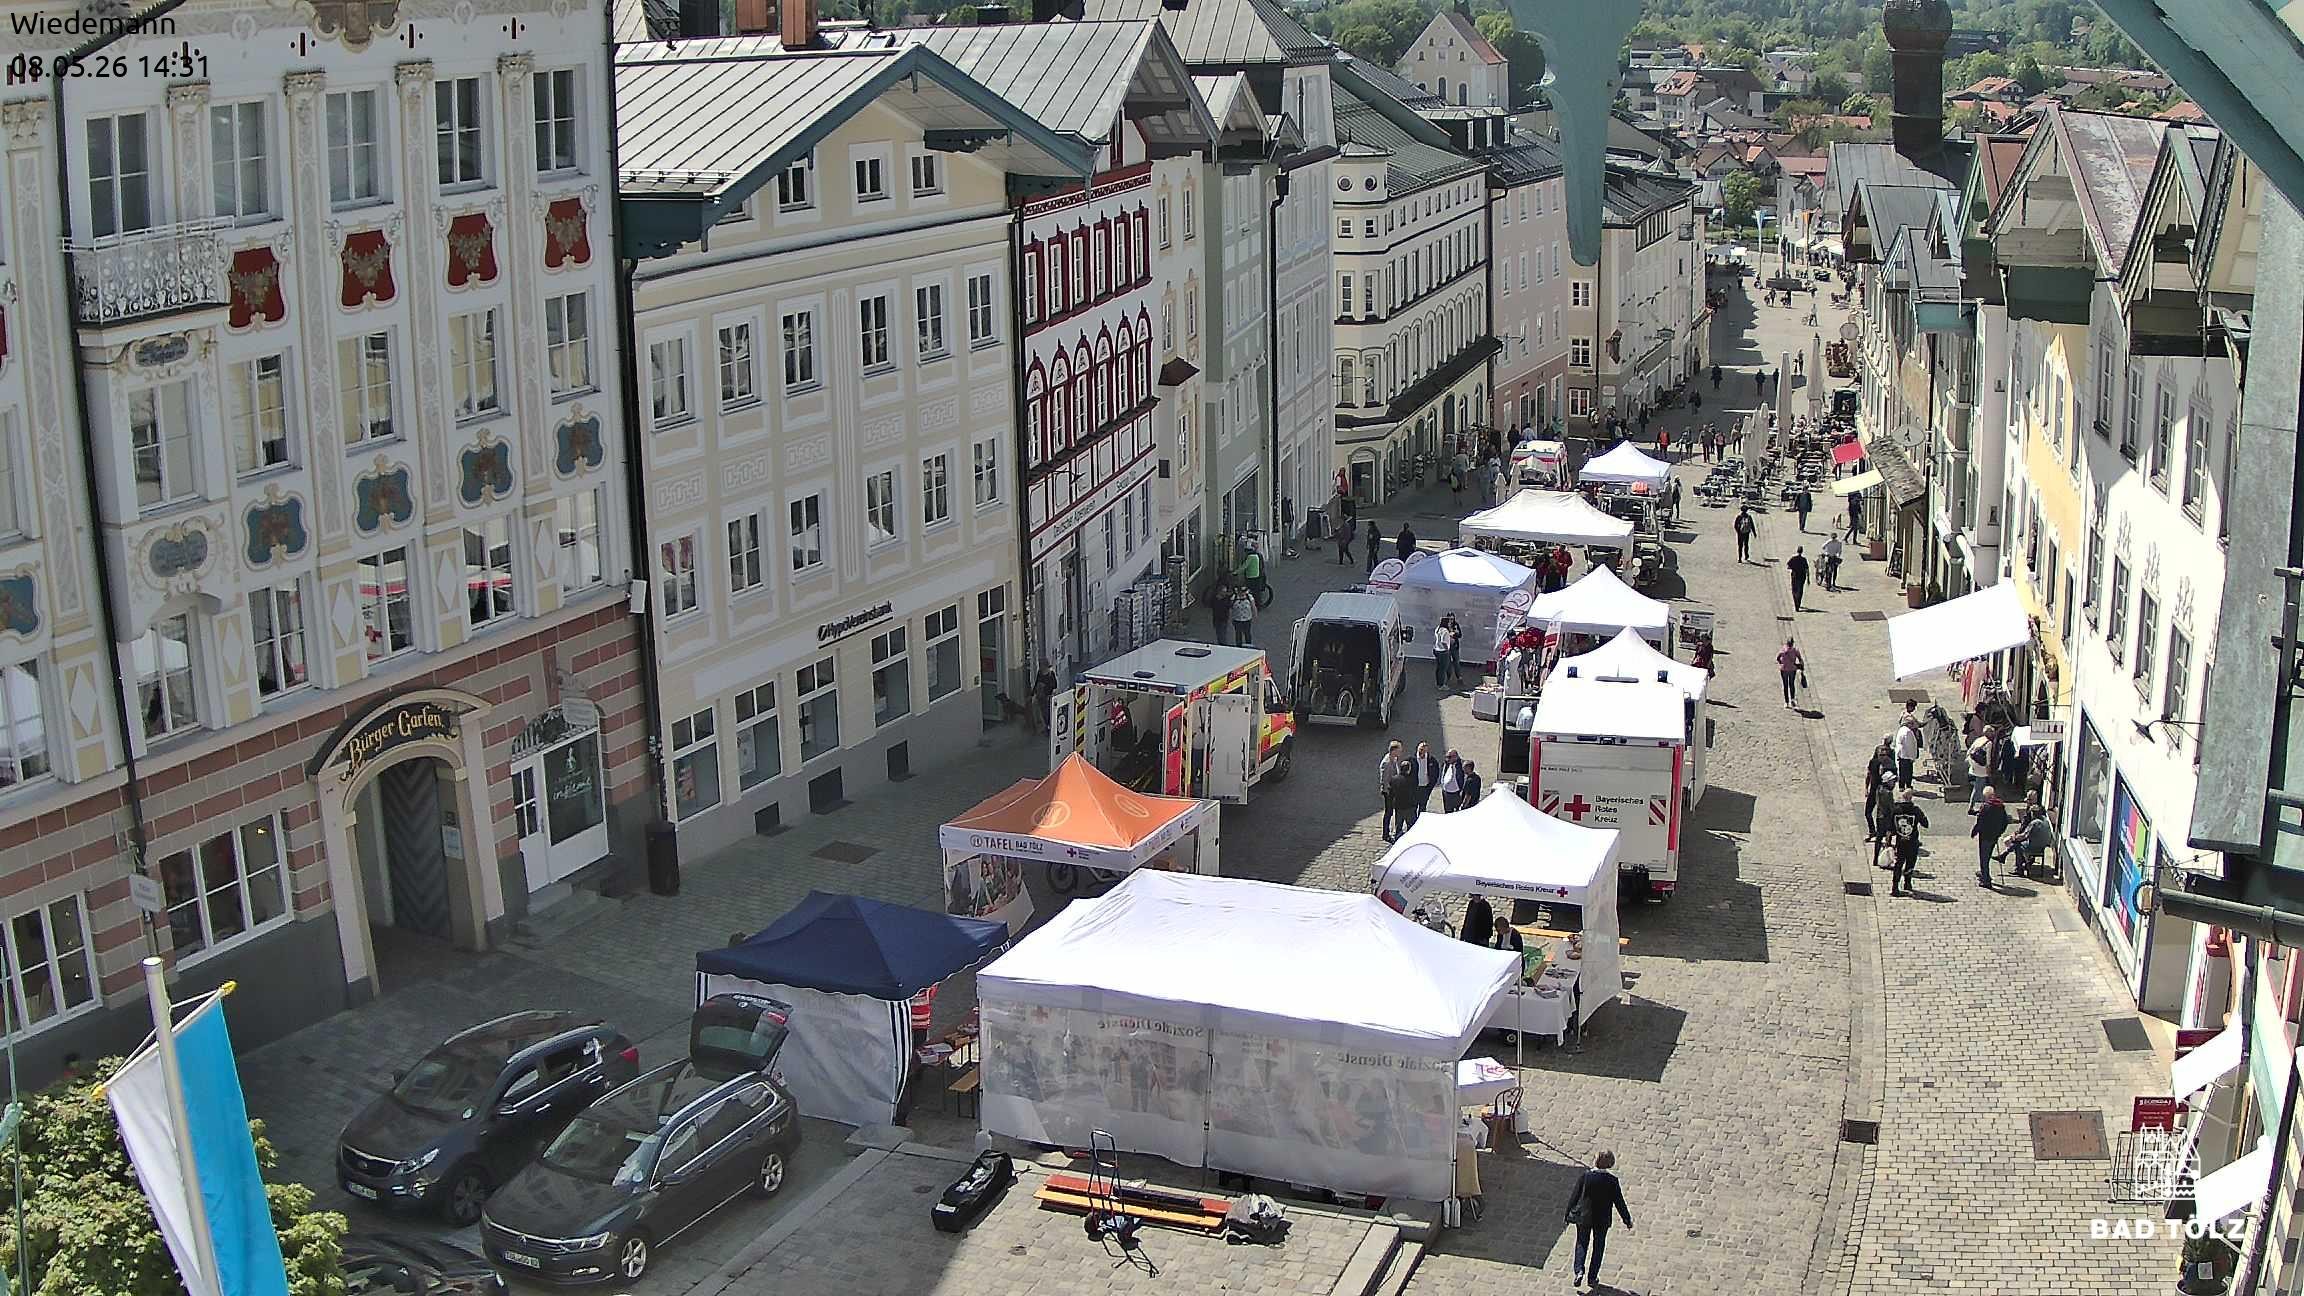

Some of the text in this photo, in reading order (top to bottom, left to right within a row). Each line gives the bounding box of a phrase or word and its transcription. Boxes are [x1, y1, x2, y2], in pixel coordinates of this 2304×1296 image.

[827, 600, 893, 639] HypoVereinsbank
[350, 721, 394, 769] Bürger
[1595, 795, 1644, 805] Bayerisches
[1595, 805, 1618, 814] Rotes
[1594, 815, 1618, 824] Kreuz
[984, 836, 1014, 851] TAFEL
[1015, 840, 1028, 849] BAD
[1475, 879, 1556, 894] Bayerisches Rotes Kreuz
